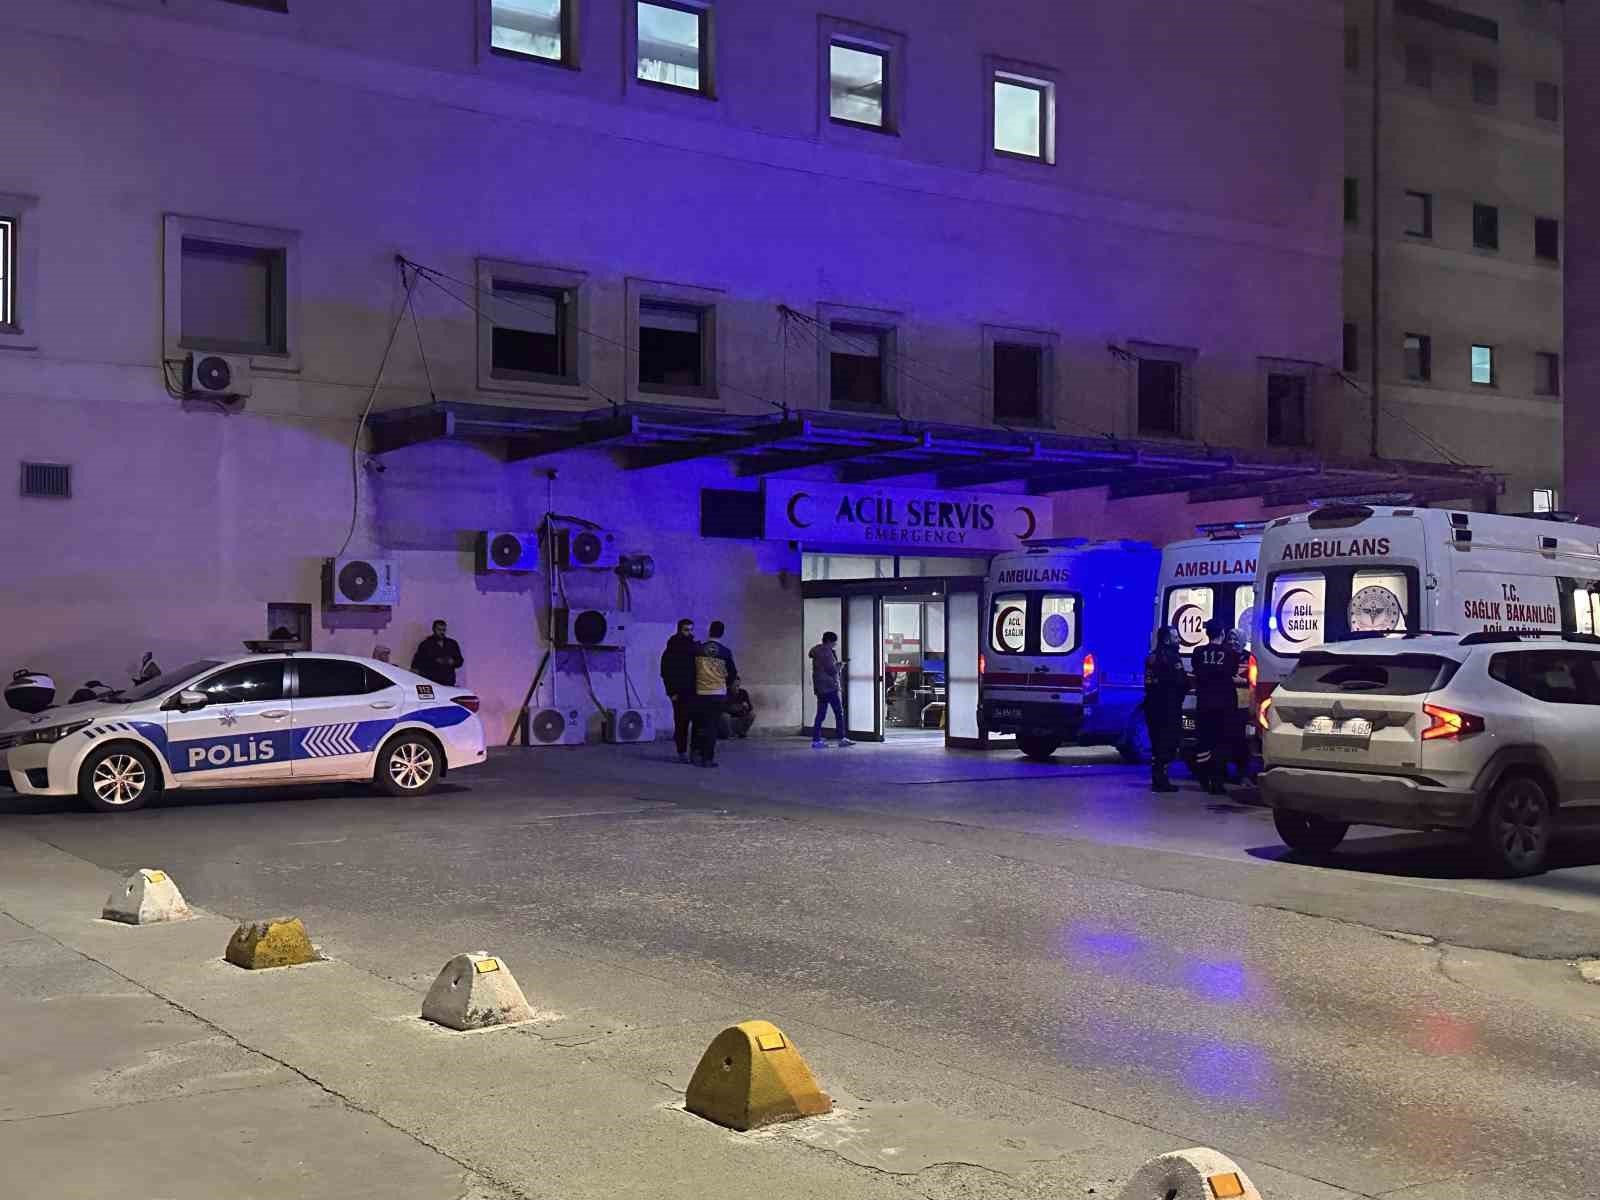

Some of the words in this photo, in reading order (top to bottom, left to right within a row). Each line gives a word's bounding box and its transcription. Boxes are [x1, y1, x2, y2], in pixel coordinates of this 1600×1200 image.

[836, 490, 898, 526] ACİL
[907, 496, 994, 530] SERVİS
[865, 527, 967, 544] EMERGENCY
[1281, 538, 1390, 560] AMBULANS
[998, 567, 1070, 584] AMBULANS
[1174, 559, 1257, 577] AMBULAN
[1501, 583, 1520, 602] T.C.
[1464, 599, 1501, 620] SAĞLIK
[1507, 603, 1556, 624] BAKANLIĞI
[1182, 616, 1202, 632] 112
[1203, 650, 1225, 665] 112
[188, 737, 275, 768] POLİS
